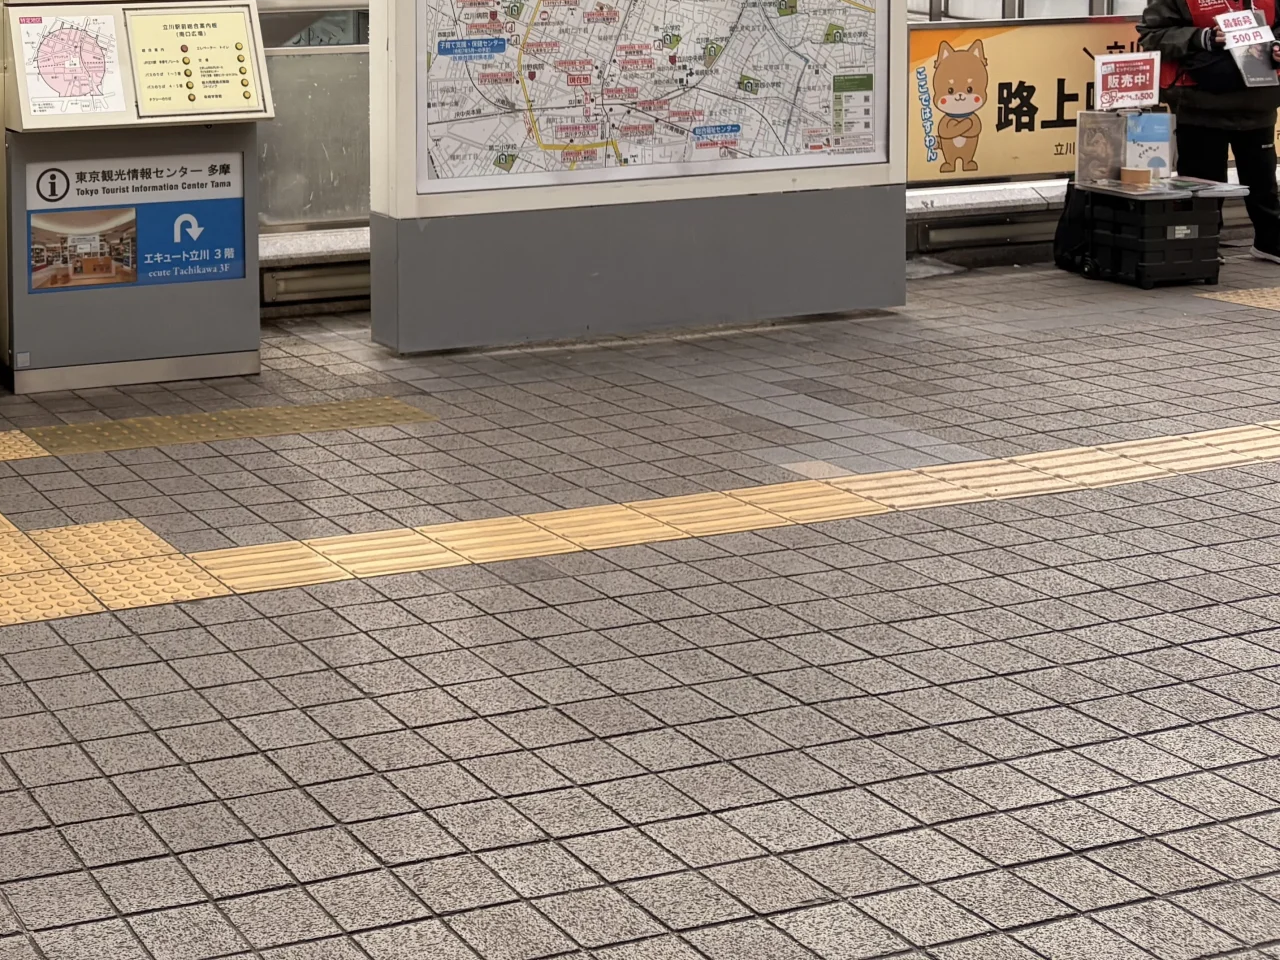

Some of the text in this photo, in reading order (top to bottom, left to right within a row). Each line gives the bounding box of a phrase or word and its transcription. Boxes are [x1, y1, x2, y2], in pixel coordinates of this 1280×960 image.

[463, 12, 489, 20] 立川病院
[1223, 16, 1252, 28] 最新号
[995, 78, 1097, 133] 路上
[75, 163, 231, 184] 東京観光情報センター 多摩
[76, 180, 231, 197] Tokyo Tourist Information Center Tama
[148, 263, 230, 277] ecute Tachikawa 3F
